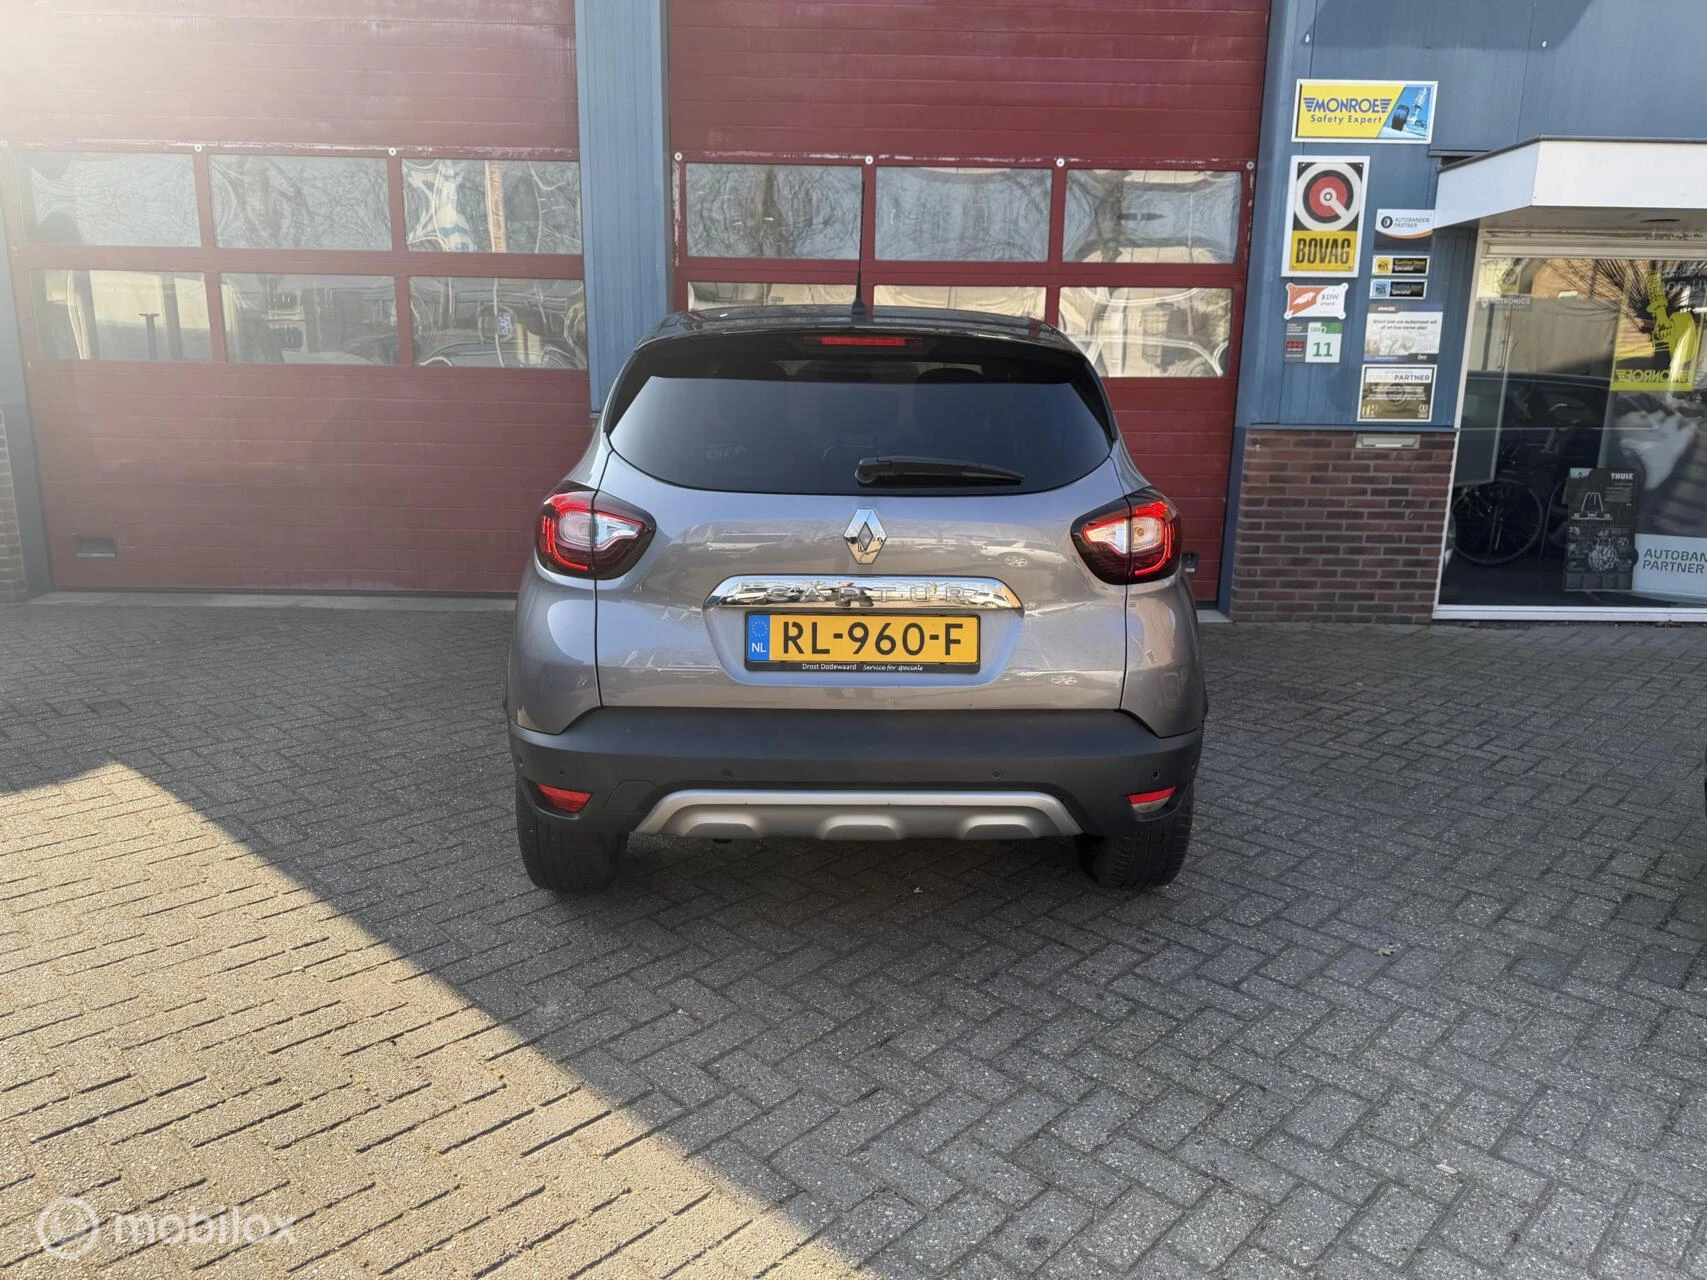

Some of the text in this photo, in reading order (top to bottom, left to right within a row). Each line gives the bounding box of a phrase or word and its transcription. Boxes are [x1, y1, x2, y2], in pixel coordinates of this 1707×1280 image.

[1313, 98, 1382, 113] MONROE
[1310, 114, 1382, 125] Safety Expert
[1295, 238, 1351, 265] BOVAG
[1313, 341, 1333, 357] 11
[1610, 472, 1635, 480] THULE
[1643, 559, 1705, 575] PARTNER
[766, 586, 965, 602] CAPTUR
[783, 621, 963, 656] RL-960-F
[751, 642, 767, 653] NL
[886, 664, 897, 672] for
[898, 664, 923, 672] specials
